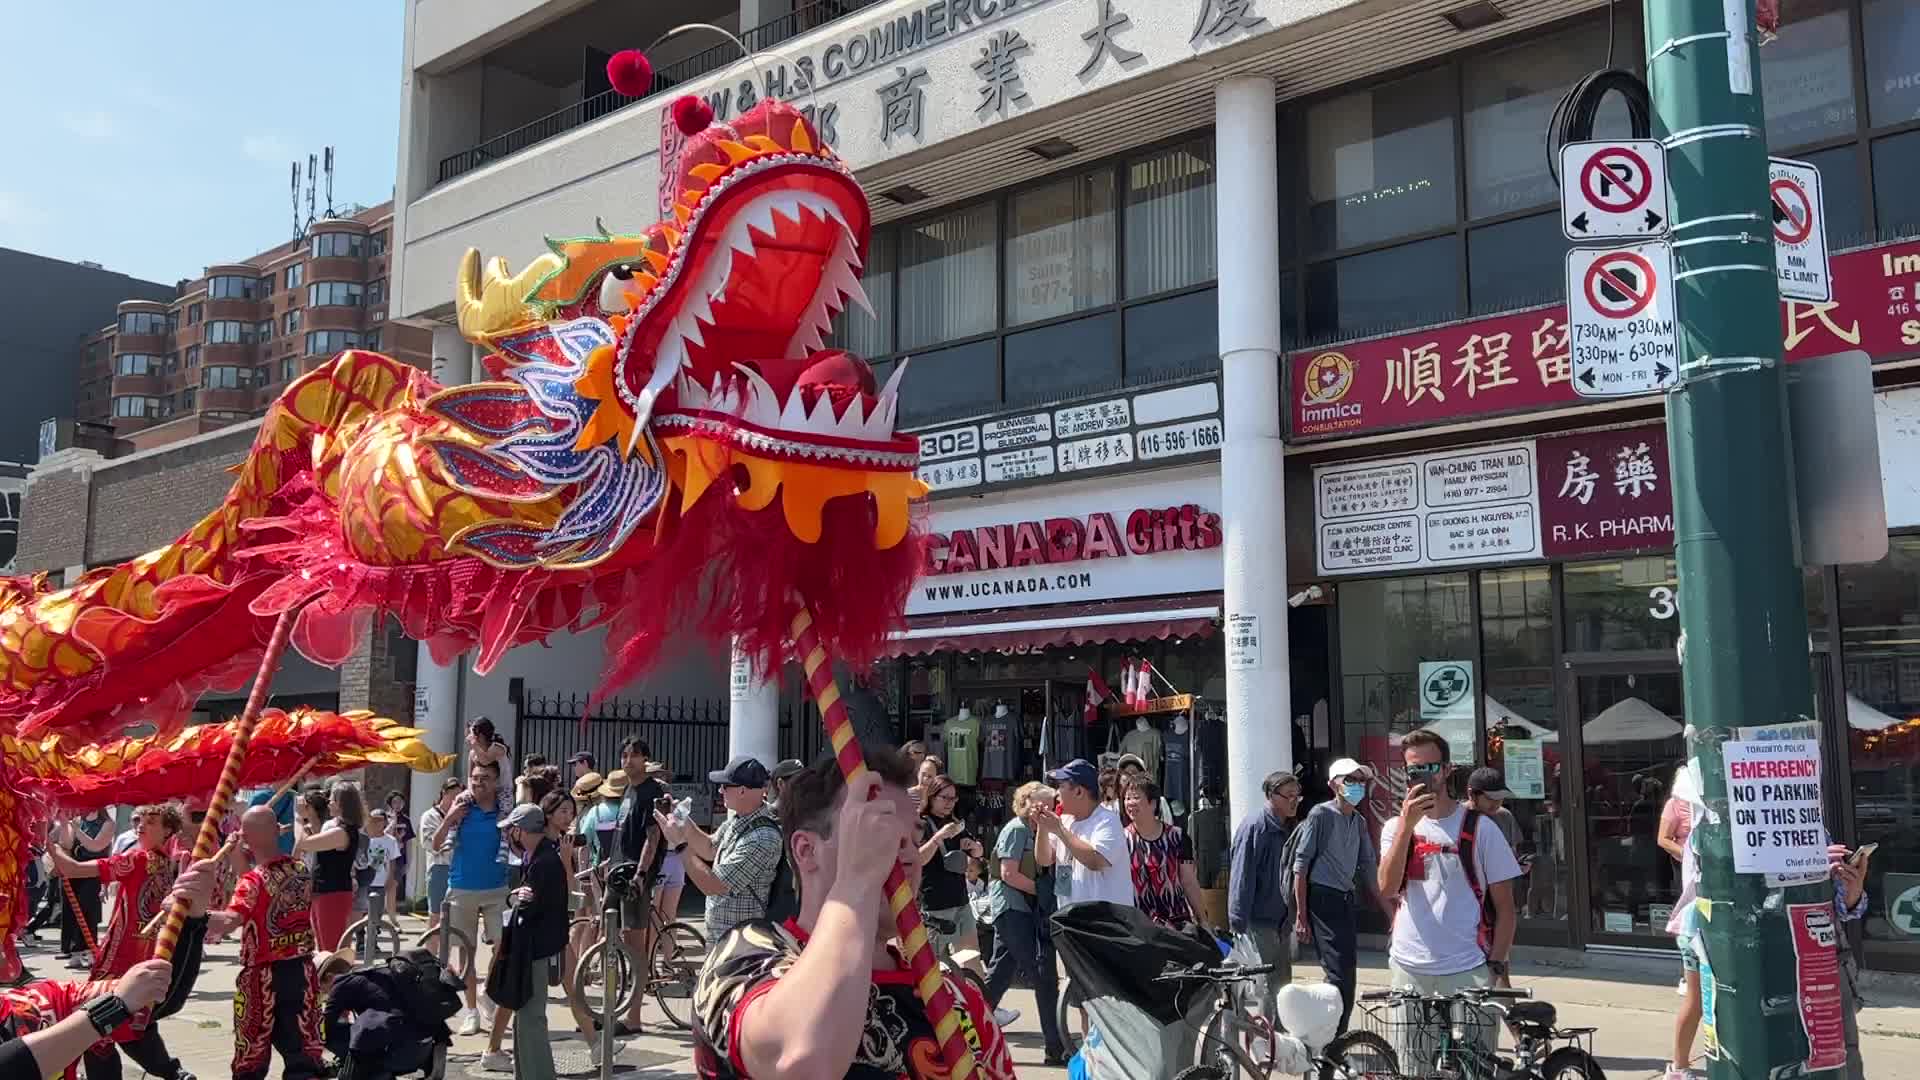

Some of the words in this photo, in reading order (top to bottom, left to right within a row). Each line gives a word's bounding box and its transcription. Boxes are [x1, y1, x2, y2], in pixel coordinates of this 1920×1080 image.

[822, 0, 1016, 79] COMMERC
[1787, 255, 1806, 269] MIN
[1777, 267, 1792, 280] LE
[1793, 272, 1820, 284] LIMIT
[1888, 303, 1909, 316] 416
[1302, 402, 1361, 422] Immica
[984, 424, 1049, 440] PROFESSIONAL
[1073, 419, 1104, 433] ANDREW
[1302, 418, 1362, 433] CONSULTATION
[921, 431, 975, 457] 302
[998, 435, 1037, 448] BUILDING
[1140, 425, 1219, 455] 416-596-1666
[1480, 457, 1504, 470] TRAN
[1470, 471, 1508, 482] PHYSICIAN
[1126, 503, 1223, 555] Gifts
[1600, 514, 1675, 537] PHARM
[1393, 544, 1414, 553] CLINIC
[925, 573, 1091, 601] WWW.UCANADA.COM
[1745, 743, 1783, 754] TORONTO
[1730, 759, 1817, 779] EMERGENCY
[1733, 785, 1755, 802] NO
[1762, 783, 1818, 801] PARKING
[1736, 809, 1756, 825] ON
[1761, 807, 1796, 825] THIS
[1747, 831, 1767, 847] OF
[1772, 829, 1819, 847] STREET
[1785, 857, 1804, 867] Chief
[1806, 857, 1812, 866] of
